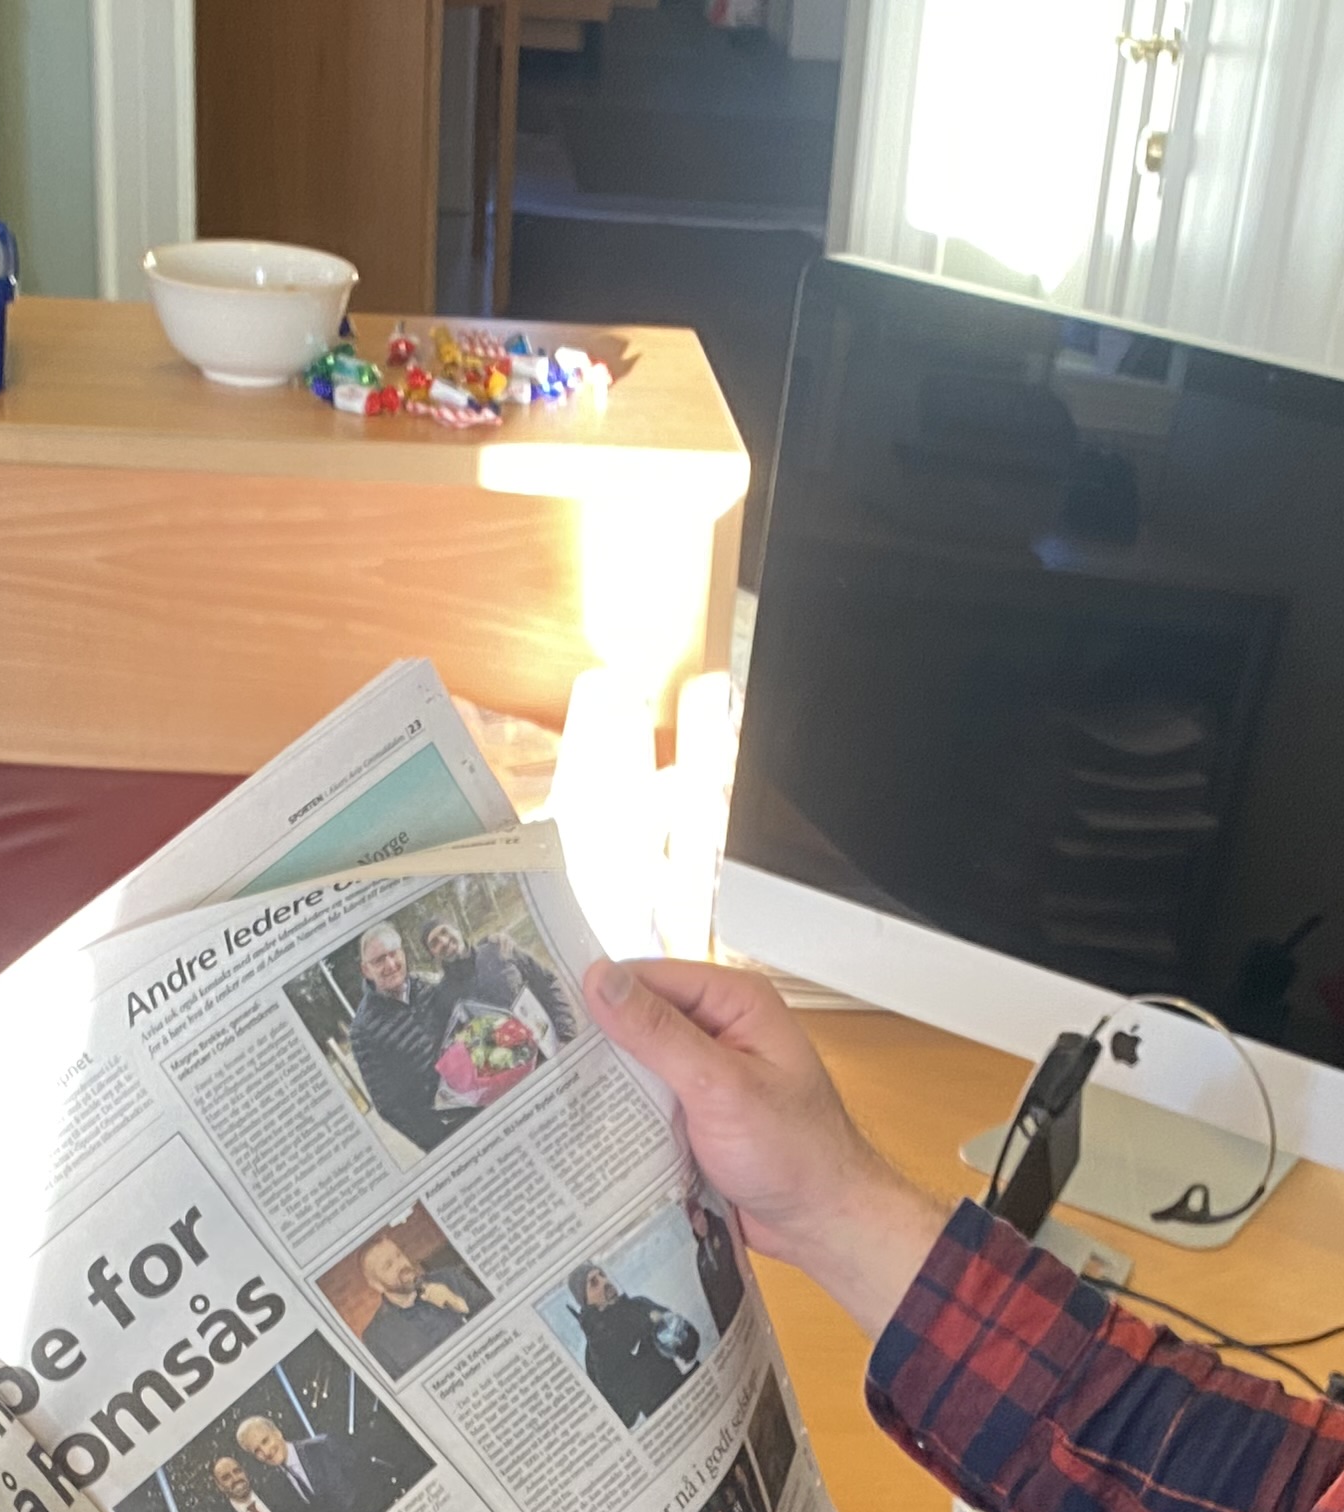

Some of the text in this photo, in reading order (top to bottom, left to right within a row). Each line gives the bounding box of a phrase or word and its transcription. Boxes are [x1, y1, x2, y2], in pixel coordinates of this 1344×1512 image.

[288, 794, 324, 825] SPORTEN
[407, 719, 423, 735] 23
[127, 887, 325, 1028] Andre ledere
[87, 1205, 209, 1329] for
[674, 1474, 698, 1512] nå
[692, 1463, 706, 1487] i
[705, 1426, 735, 1480] godt
